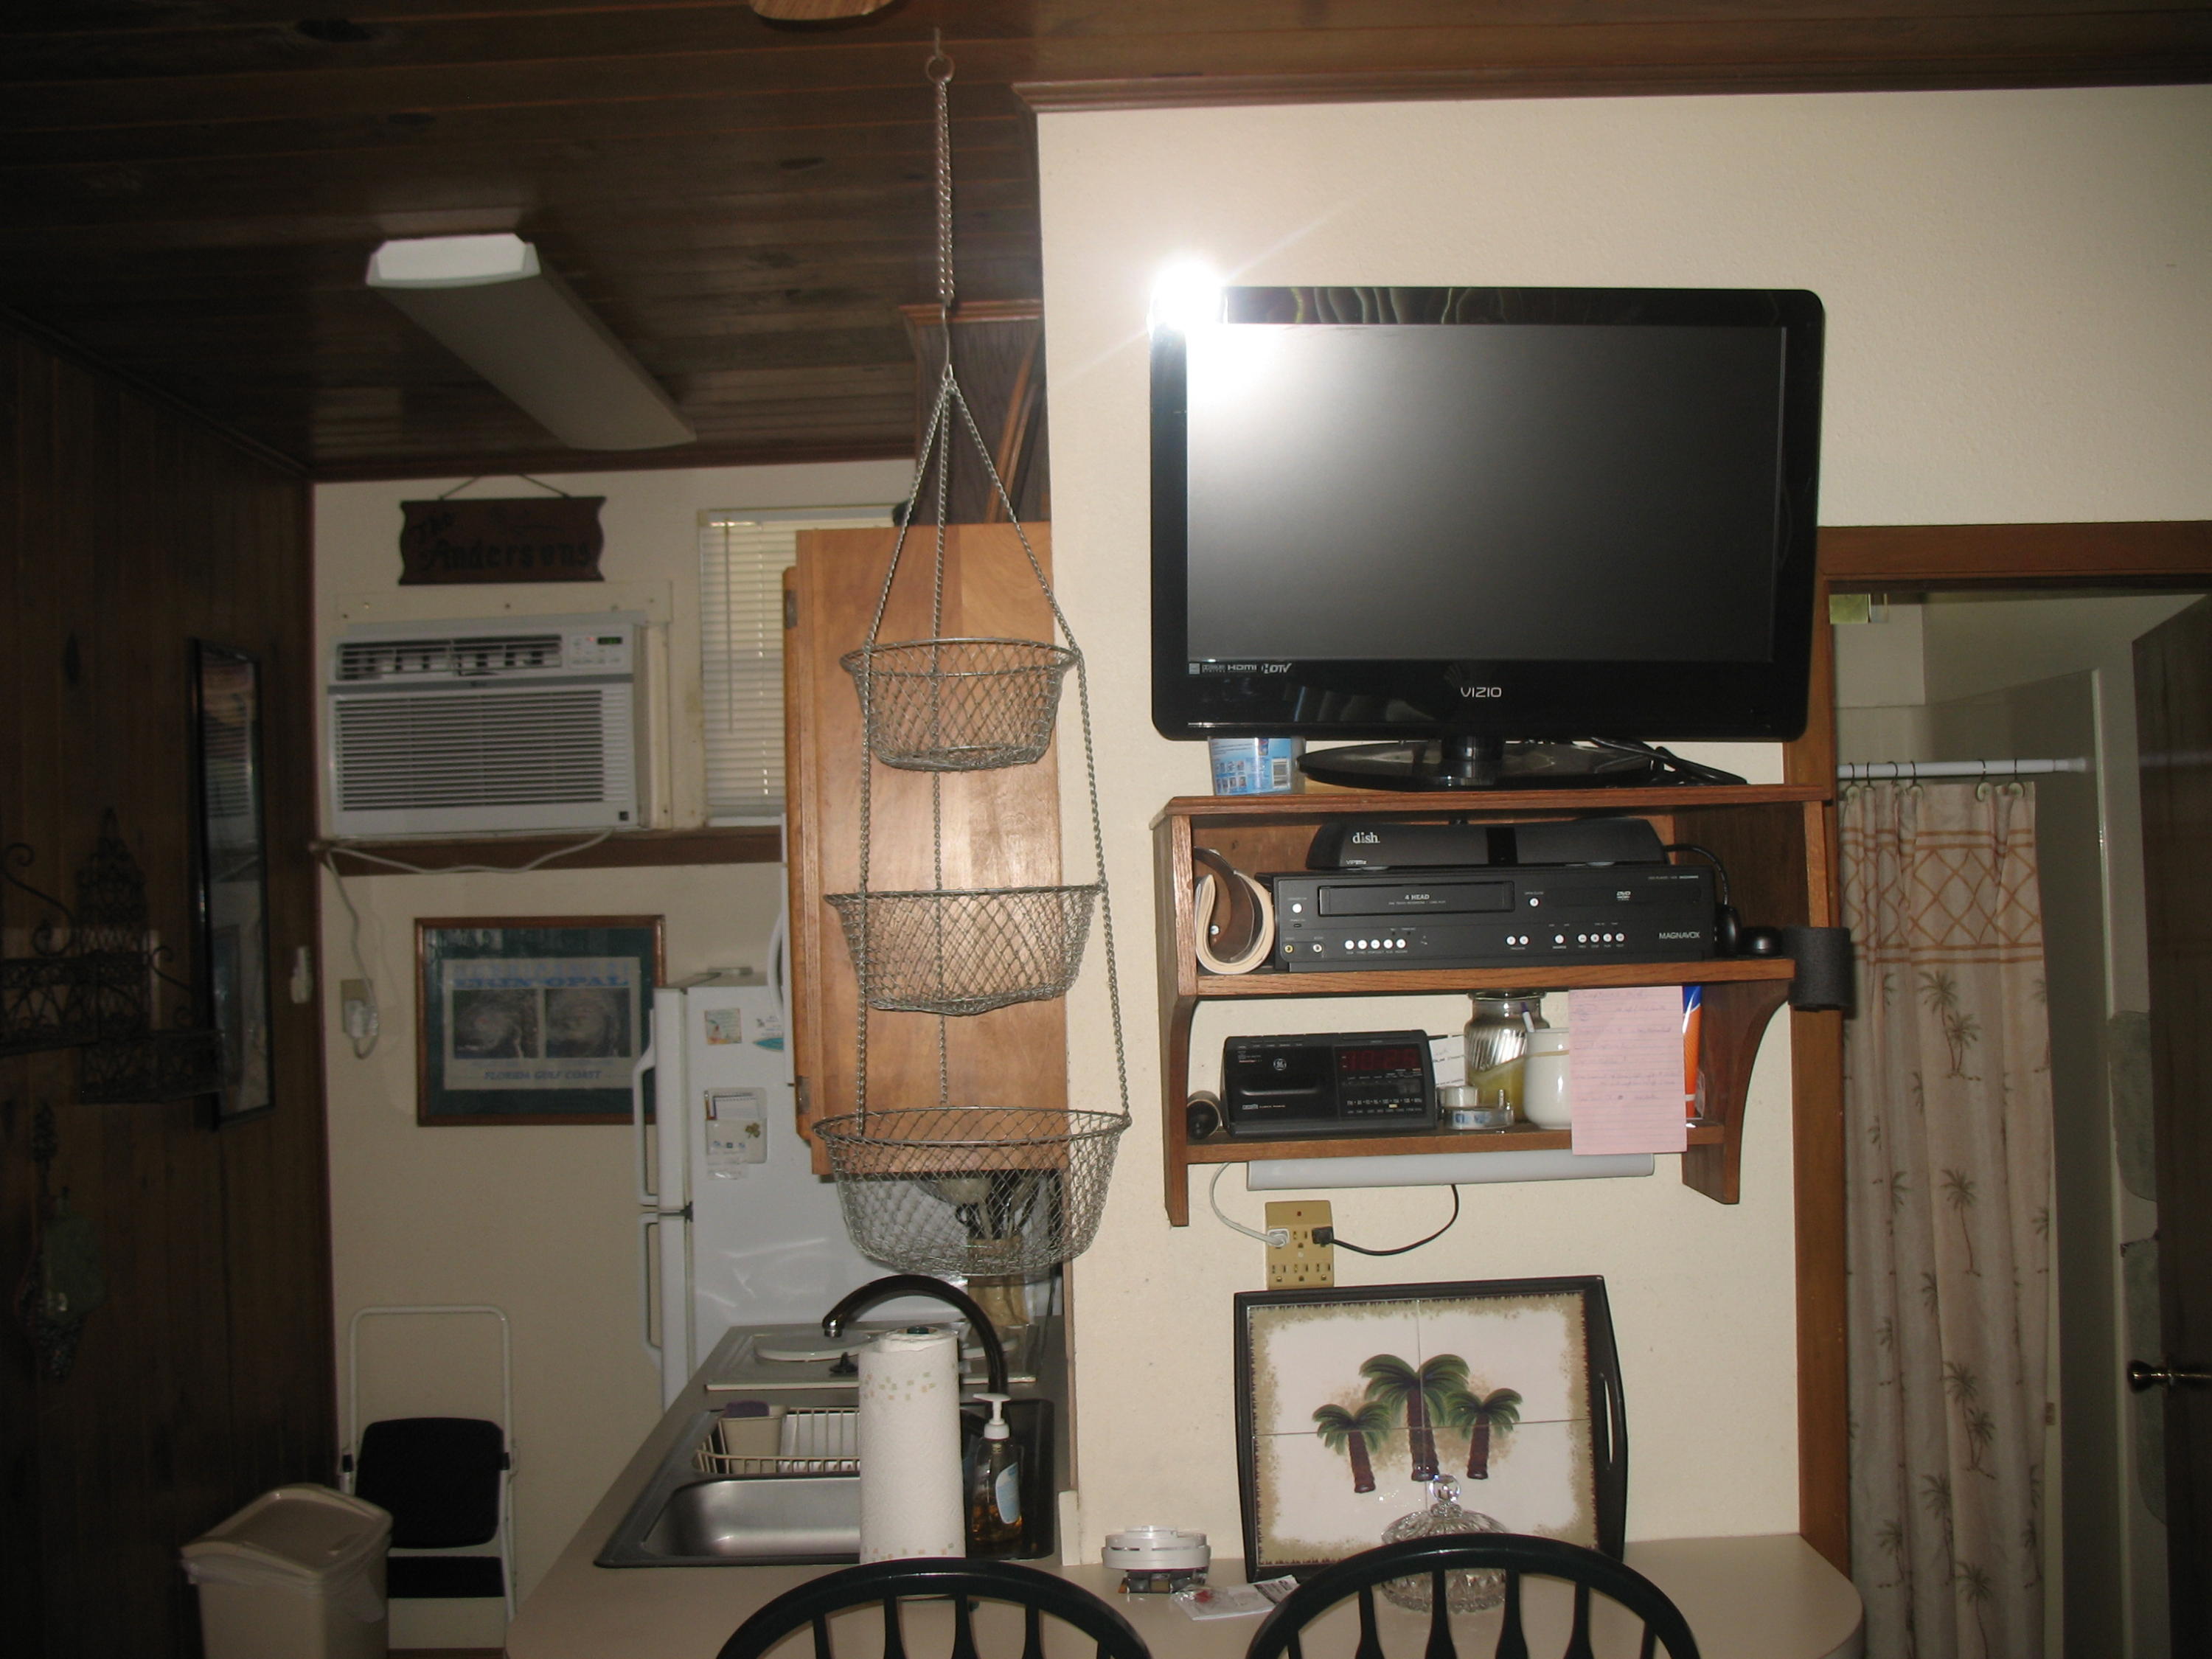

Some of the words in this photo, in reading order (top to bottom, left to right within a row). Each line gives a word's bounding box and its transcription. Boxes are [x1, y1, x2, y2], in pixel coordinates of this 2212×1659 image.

[1461, 687, 1502, 698] VIZIO
[1352, 832, 1380, 844] dish
[1658, 931, 1700, 939] MAGNAVOX
